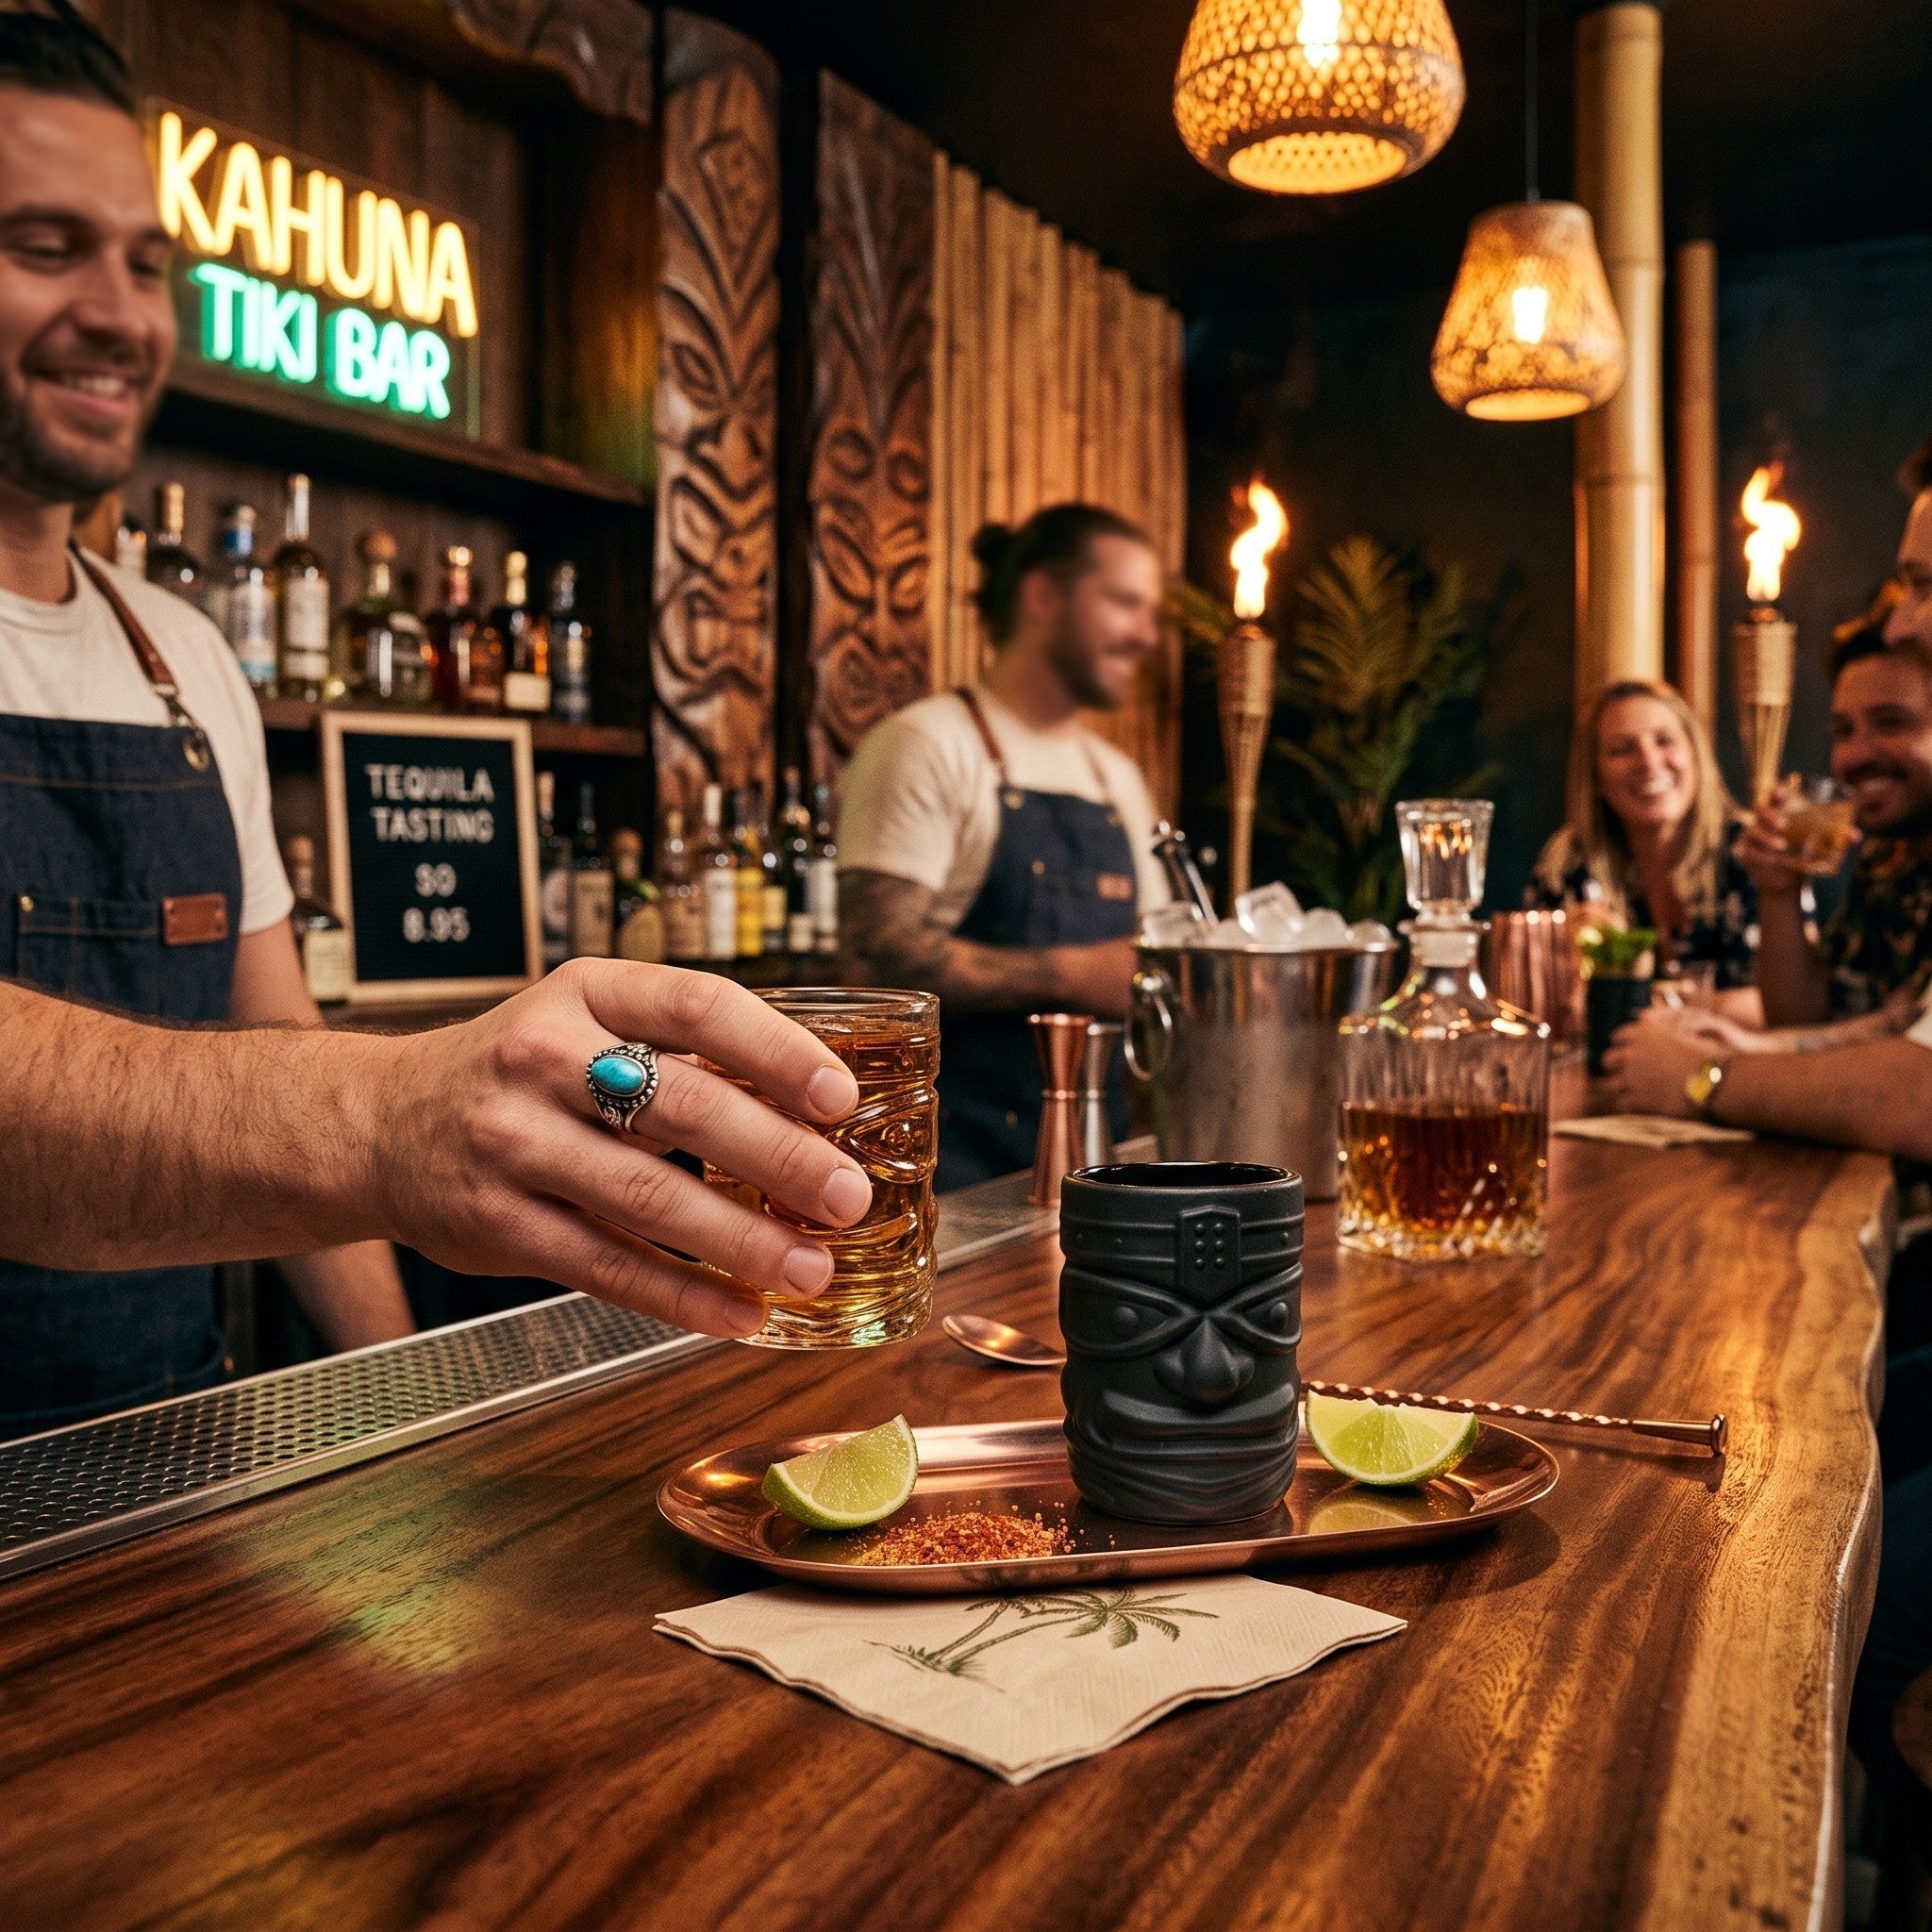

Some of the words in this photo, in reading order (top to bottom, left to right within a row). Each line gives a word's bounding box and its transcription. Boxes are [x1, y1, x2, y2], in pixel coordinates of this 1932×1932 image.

[159, 111, 478, 338] KAHUNA
[192, 262, 318, 383] TIKI
[330, 308, 451, 419] BAR
[365, 764, 495, 802] TEQUILA
[371, 807, 495, 843] TASTING
